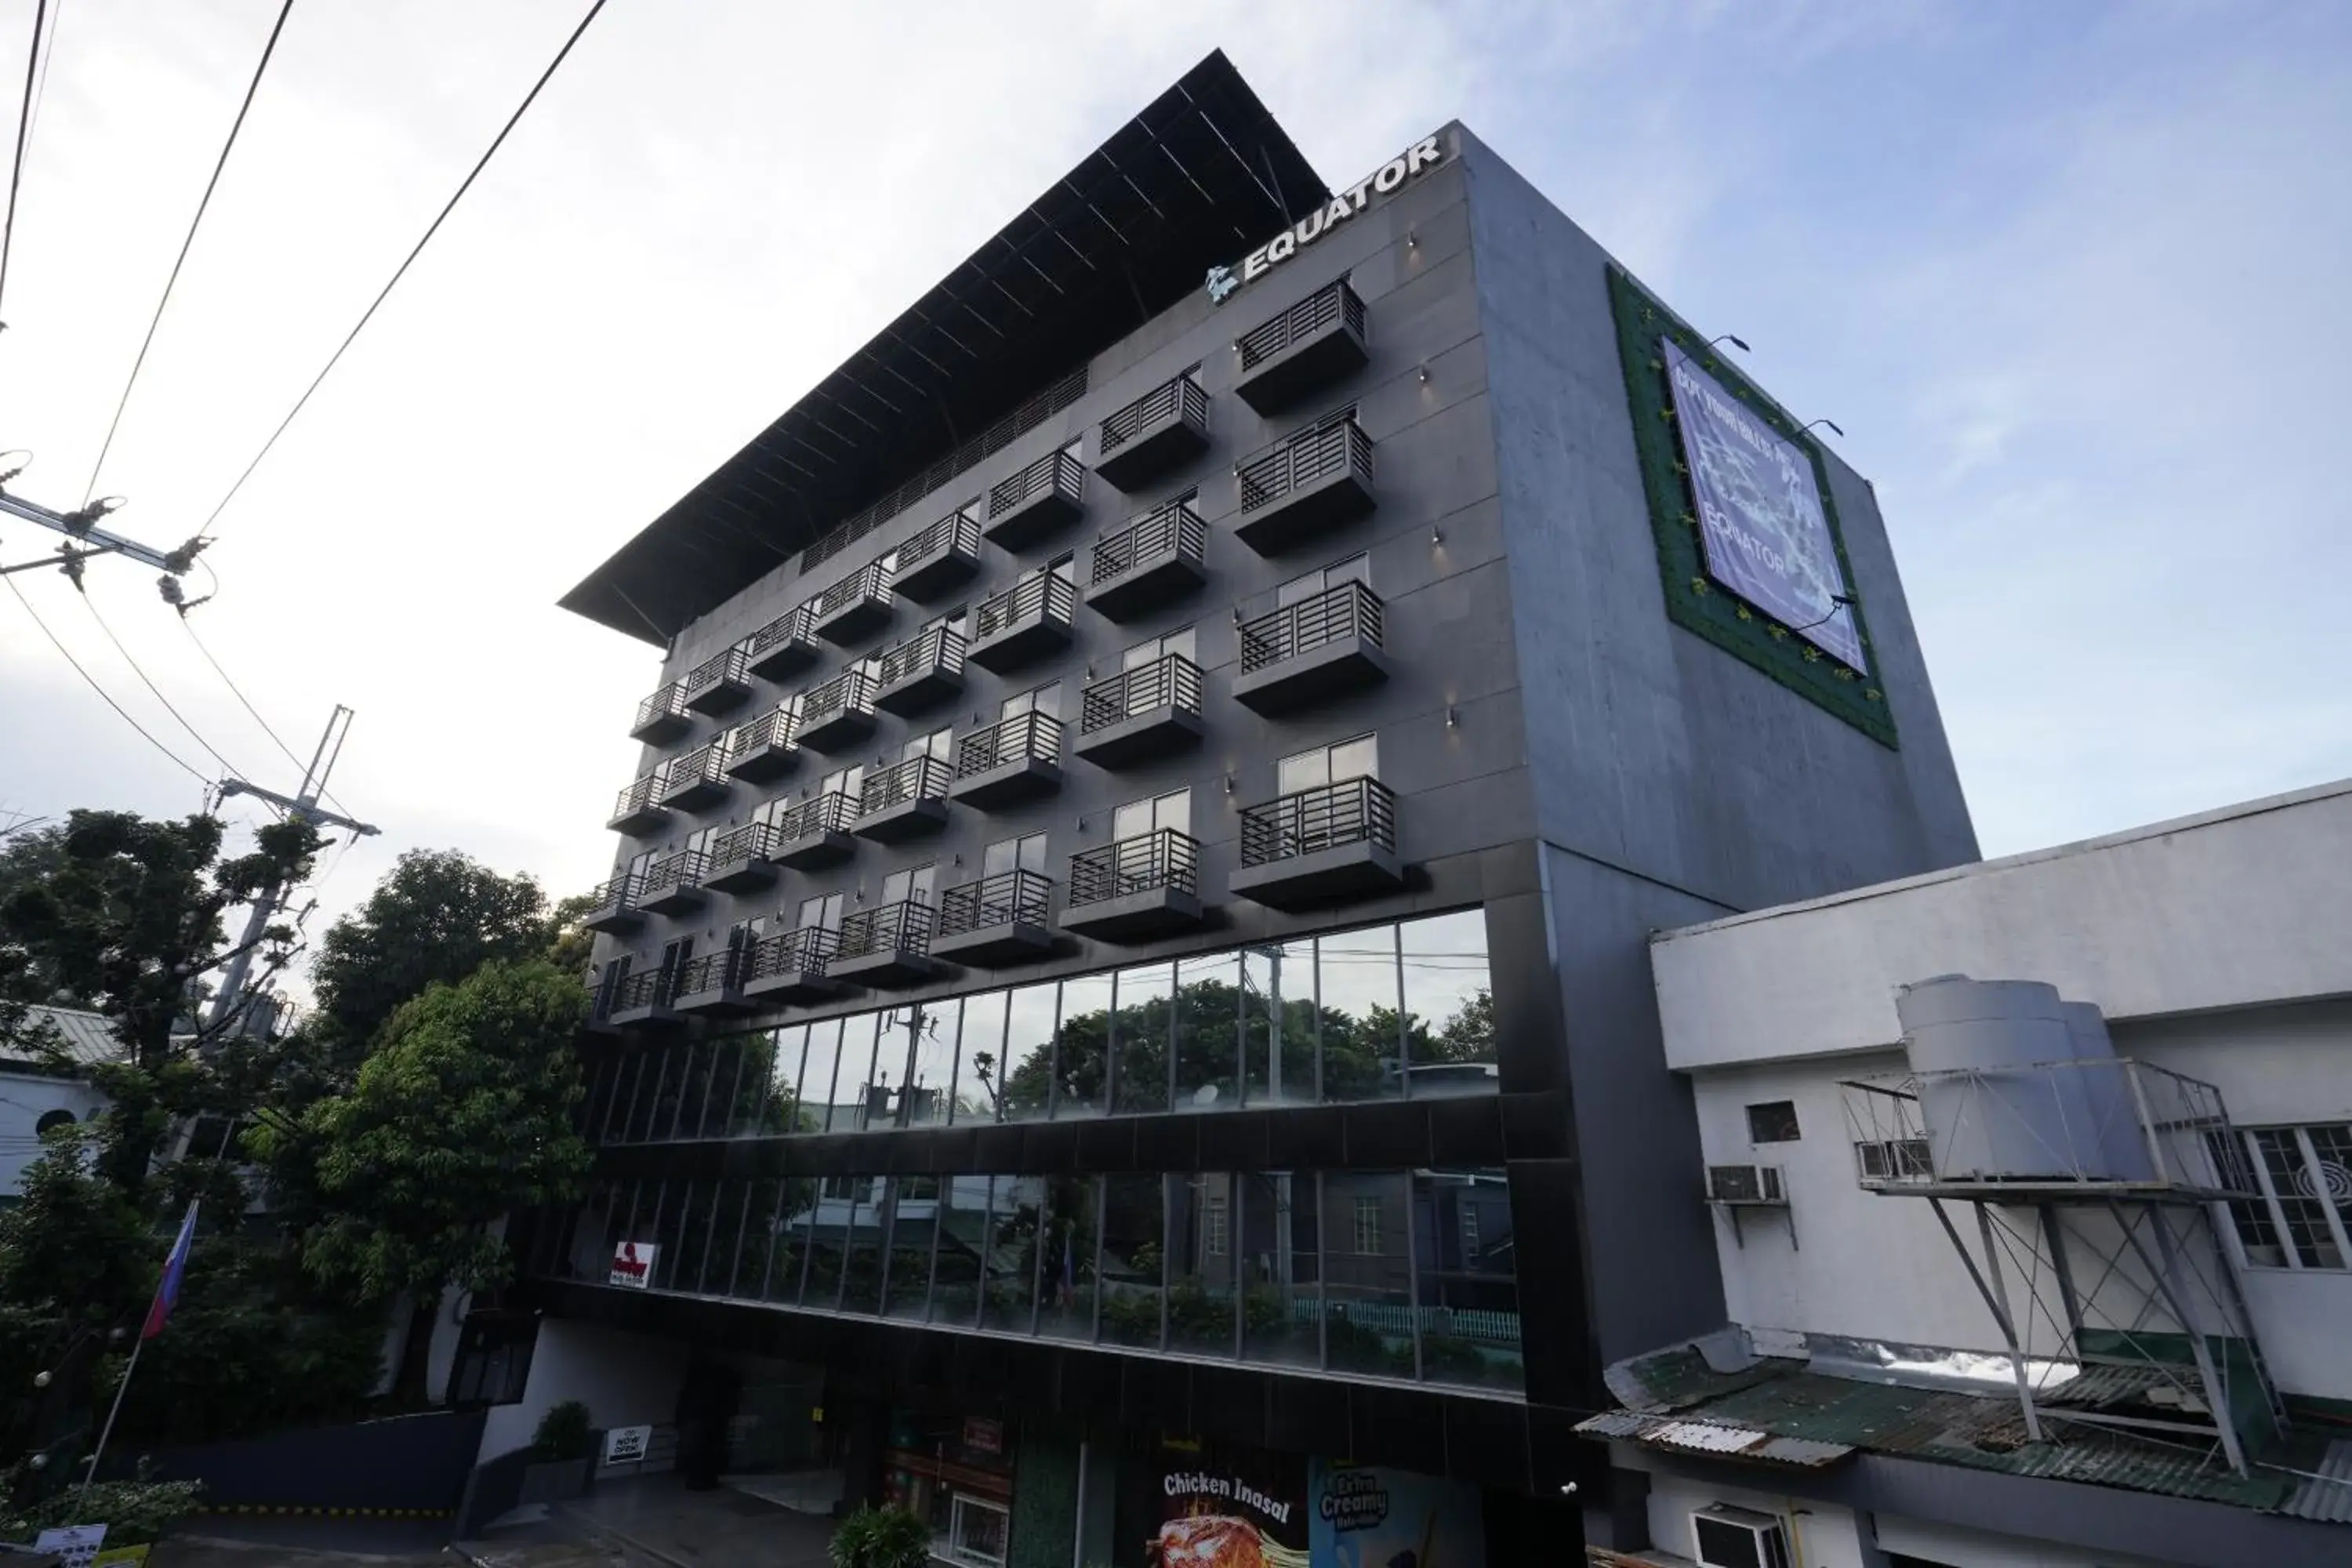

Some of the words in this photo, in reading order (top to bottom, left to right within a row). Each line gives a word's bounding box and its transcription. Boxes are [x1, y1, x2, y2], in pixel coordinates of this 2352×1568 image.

[1244, 136, 1441, 282] EQUATOR
[1703, 501, 1787, 579] EQUATOR
[1163, 1472, 1230, 1497] Chicken
[1233, 1477, 1290, 1525] Inasal
[1320, 1493, 1388, 1518] Creamy
